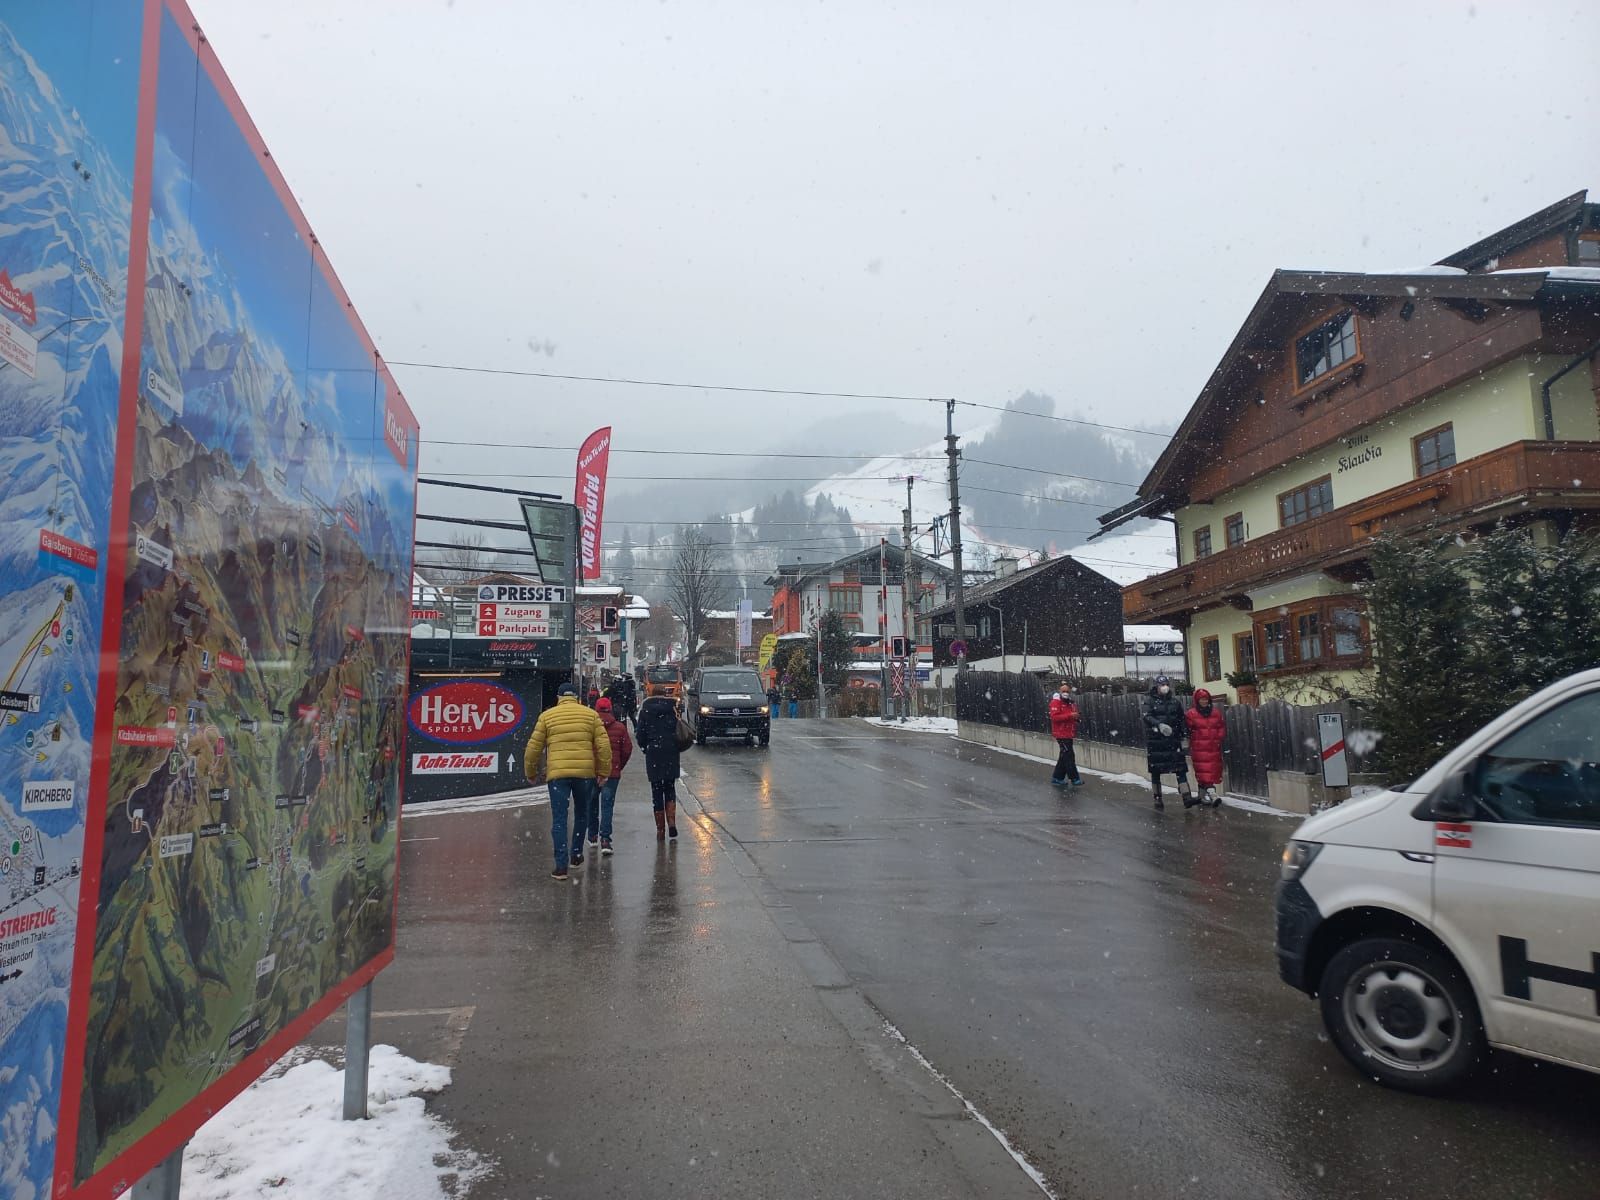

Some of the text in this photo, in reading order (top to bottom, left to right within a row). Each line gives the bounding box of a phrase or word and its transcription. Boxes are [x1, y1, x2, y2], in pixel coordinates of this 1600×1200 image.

[1338, 445, 1382, 473] Klaudia
[42, 535, 72, 558] Gaisberg
[497, 586, 552, 601] PRESSE
[504, 607, 542, 618] Zugang
[498, 623, 547, 635] Parkplatz
[1, 695, 28, 711] Gaisberg
[420, 695, 515, 730] Hervis
[25, 788, 72, 804] KIRCHBERG
[0, 905, 57, 938] STREIFZUG
[20, 935, 29, 946] im
[31, 931, 47, 943] Thale
[0, 947, 34, 968] estendorf
